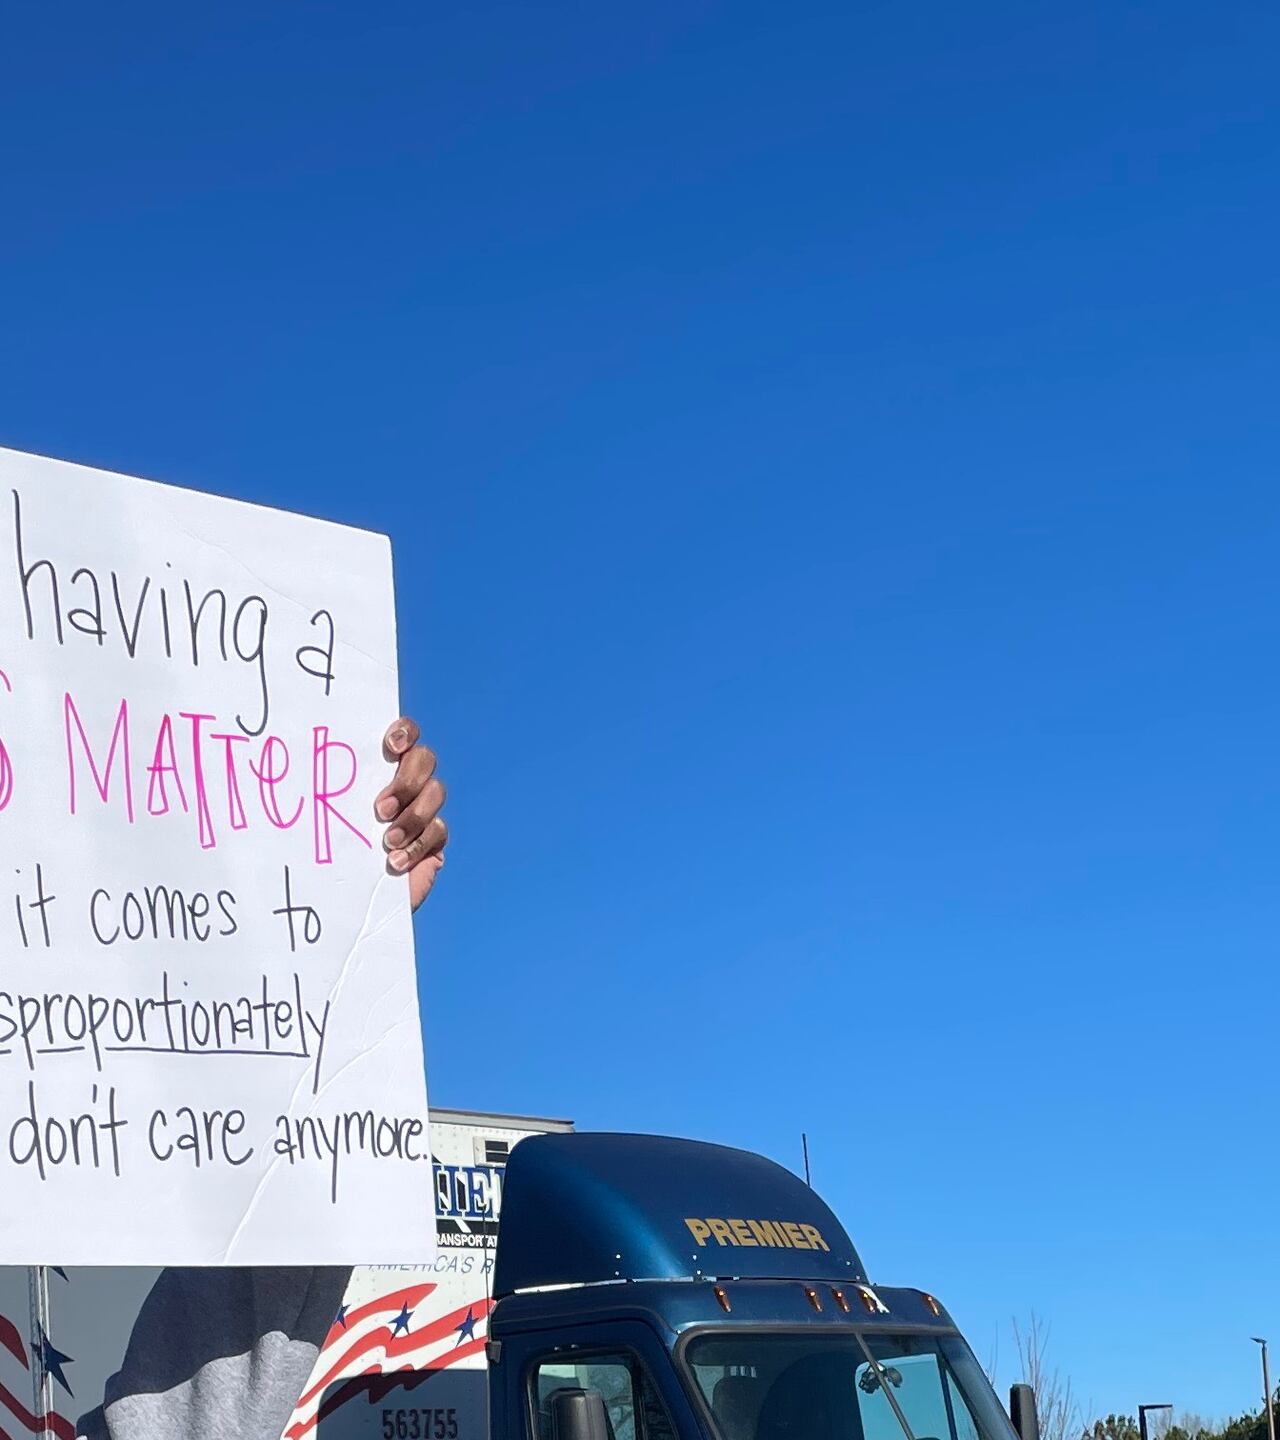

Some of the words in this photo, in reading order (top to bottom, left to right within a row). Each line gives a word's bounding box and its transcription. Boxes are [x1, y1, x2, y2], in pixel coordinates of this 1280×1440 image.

[12, 489, 268, 737] having
[295, 608, 336, 697] a
[15, 863, 57, 948] it
[90, 885, 238, 945] comes
[272, 865, 322, 952] to
[9, 1080, 129, 1181] don't
[148, 1105, 255, 1168] care
[273, 1105, 429, 1204] anymore.
[685, 1218, 831, 1252] PREMIER
[382, 1408, 459, 1440] 563755
